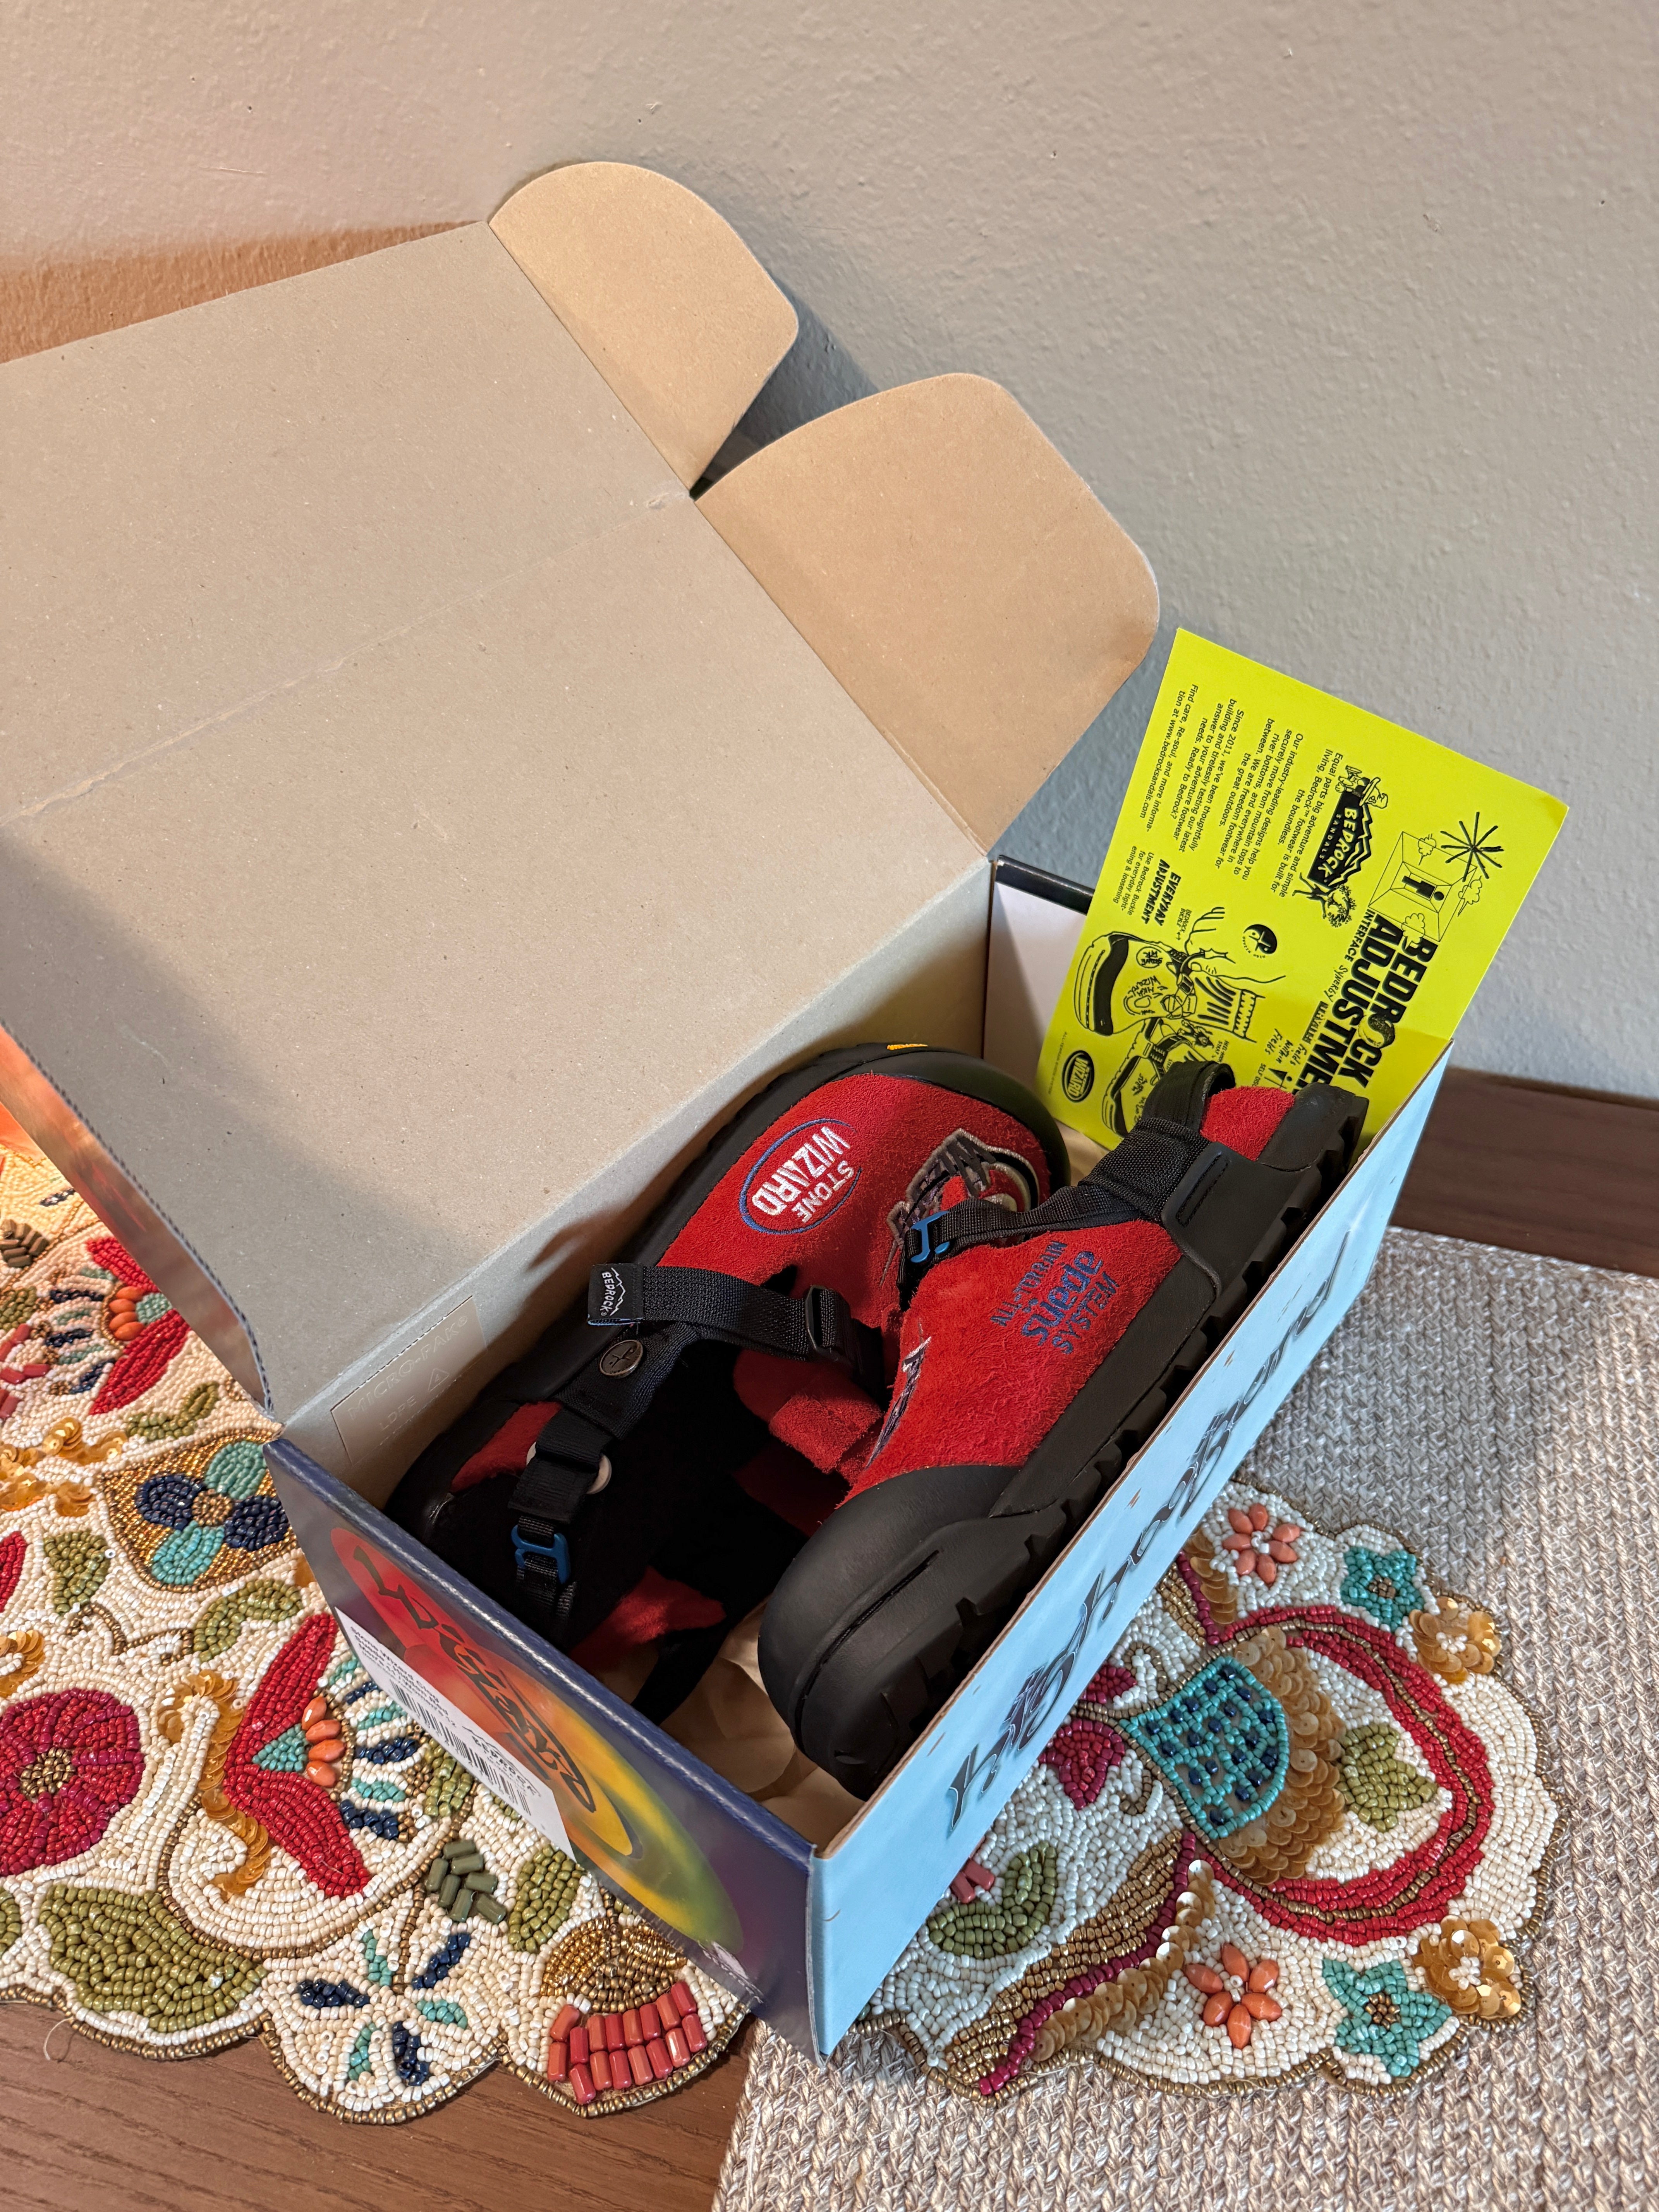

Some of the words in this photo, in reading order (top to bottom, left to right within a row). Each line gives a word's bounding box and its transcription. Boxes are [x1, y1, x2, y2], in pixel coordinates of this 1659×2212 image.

[1175, 690, 1185, 706] tion
[1187, 684, 1198, 702] Find
[1172, 708, 1179, 718] at
[1179, 704, 1190, 723] care,
[1209, 703, 1223, 733] answer
[1219, 699, 1237, 732] building
[1231, 709, 1244, 732] Since
[1168, 726, 1185, 758] Re-soul,
[1195, 718, 1207, 743] needs.
[1206, 735, 1214, 743] to
[1214, 733, 1224, 750] and
[1256, 718, 1274, 754] between.
[1293, 733, 1303, 750] Our
[1199, 745, 1209, 764] your
[1221, 734, 1236, 756] 2011,
[1268, 733, 1279, 754] river
[1274, 729, 1292, 764] securely
[1140, 720, 1175, 818] www.bedrocksandals.com
[1164, 761, 1172, 777] and
[1185, 747, 1199, 772] Ready
[1201, 751, 1219, 787] tirelessly
[1214, 760, 1225, 783] we've
[1241, 753, 1251, 766] the
[1250, 759, 1261, 771] We
[1253, 754, 1273, 789] bottoms,
[1316, 749, 1333, 773] living,
[1328, 752, 1343, 776] Equal
[1156, 778, 1167, 798] more
[1183, 773, 1190, 781] to
[1185, 766, 1202, 805] adventure
[1232, 767, 1244, 790] great
[1245, 772, 1254, 786] are
[1266, 765, 1279, 788] move
[1266, 750, 1297, 815] industry-leading
[1319, 777, 1332, 799] parts
[1170, 783, 1187, 819] Bedrock?
[1191, 788, 1206, 814] testing
[1206, 784, 1218, 804] been
[1232, 788, 1250, 820] freedom
[1248, 792, 1257, 808] and
[1258, 790, 1271, 809] from
[1295, 789, 1305, 802] the
[1304, 776, 1322, 817] Bedrock™
[1312, 800, 1324, 813] big
[1146, 800, 1161, 832] informa-
[1219, 791, 1236, 826] outdoors.
[1173, 807, 1189, 840] footwear
[1187, 816, 1195, 830] our
[1188, 805, 1210, 851] thoughtfully
[1230, 809, 1251, 854] everywhere
[1244, 811, 1262, 847] mountain
[1255, 817, 1271, 847] designs
[1278, 804, 1300, 845] boundless.
[1286, 818, 1305, 853] footwear
[1297, 815, 1317, 855] adventure
[1178, 831, 1191, 852] latest
[1219, 822, 1237, 856] footwear
[1317, 807, 1357, 878] BEDROCK
[1319, 814, 1341, 859] SANDALS
[1126, 846, 1137, 864] ening
[1145, 852, 1154, 864] Use
[1215, 857, 1224, 869] for
[1237, 848, 1248, 865] tops
[1247, 848, 1260, 864] help
[1290, 856, 1300, 872] and
[1126, 862, 1140, 892] everyday
[1135, 866, 1149, 893] Bedrock
[1242, 866, 1251, 880] you
[1275, 862, 1288, 880] built
[1113, 872, 1129, 903] loosening
[1141, 859, 1170, 924] ADJUSTMENT
[1270, 881, 1279, 893] for
[1279, 872, 1293, 897] simple
[1121, 893, 1130, 910] tight-
[1127, 894, 1139, 915] Buckle
[1154, 872, 1181, 926] EVERYDAY
[1180, 909, 1192, 933] BEDROCK
[1345, 909, 1375, 962] INTERFACE
[1323, 965, 1348, 1002] SYNERGY
[1292, 914, 1403, 1095] ADJUSTME
[1265, 1028, 1283, 1054] Fields
[1290, 1043, 1307, 1065] Fields
[1067, 1057, 1089, 1097] WIZARD
[1257, 1063, 1266, 1077] SELF
[752, 1126, 850, 1216] WIZARD
[791, 1160, 854, 1223] STONE
[990, 1240, 1068, 1326] ALL-TERRAIN
[1052, 1270, 1120, 1355] SYSTEM
[379, 1395, 417, 1431] LDPE
